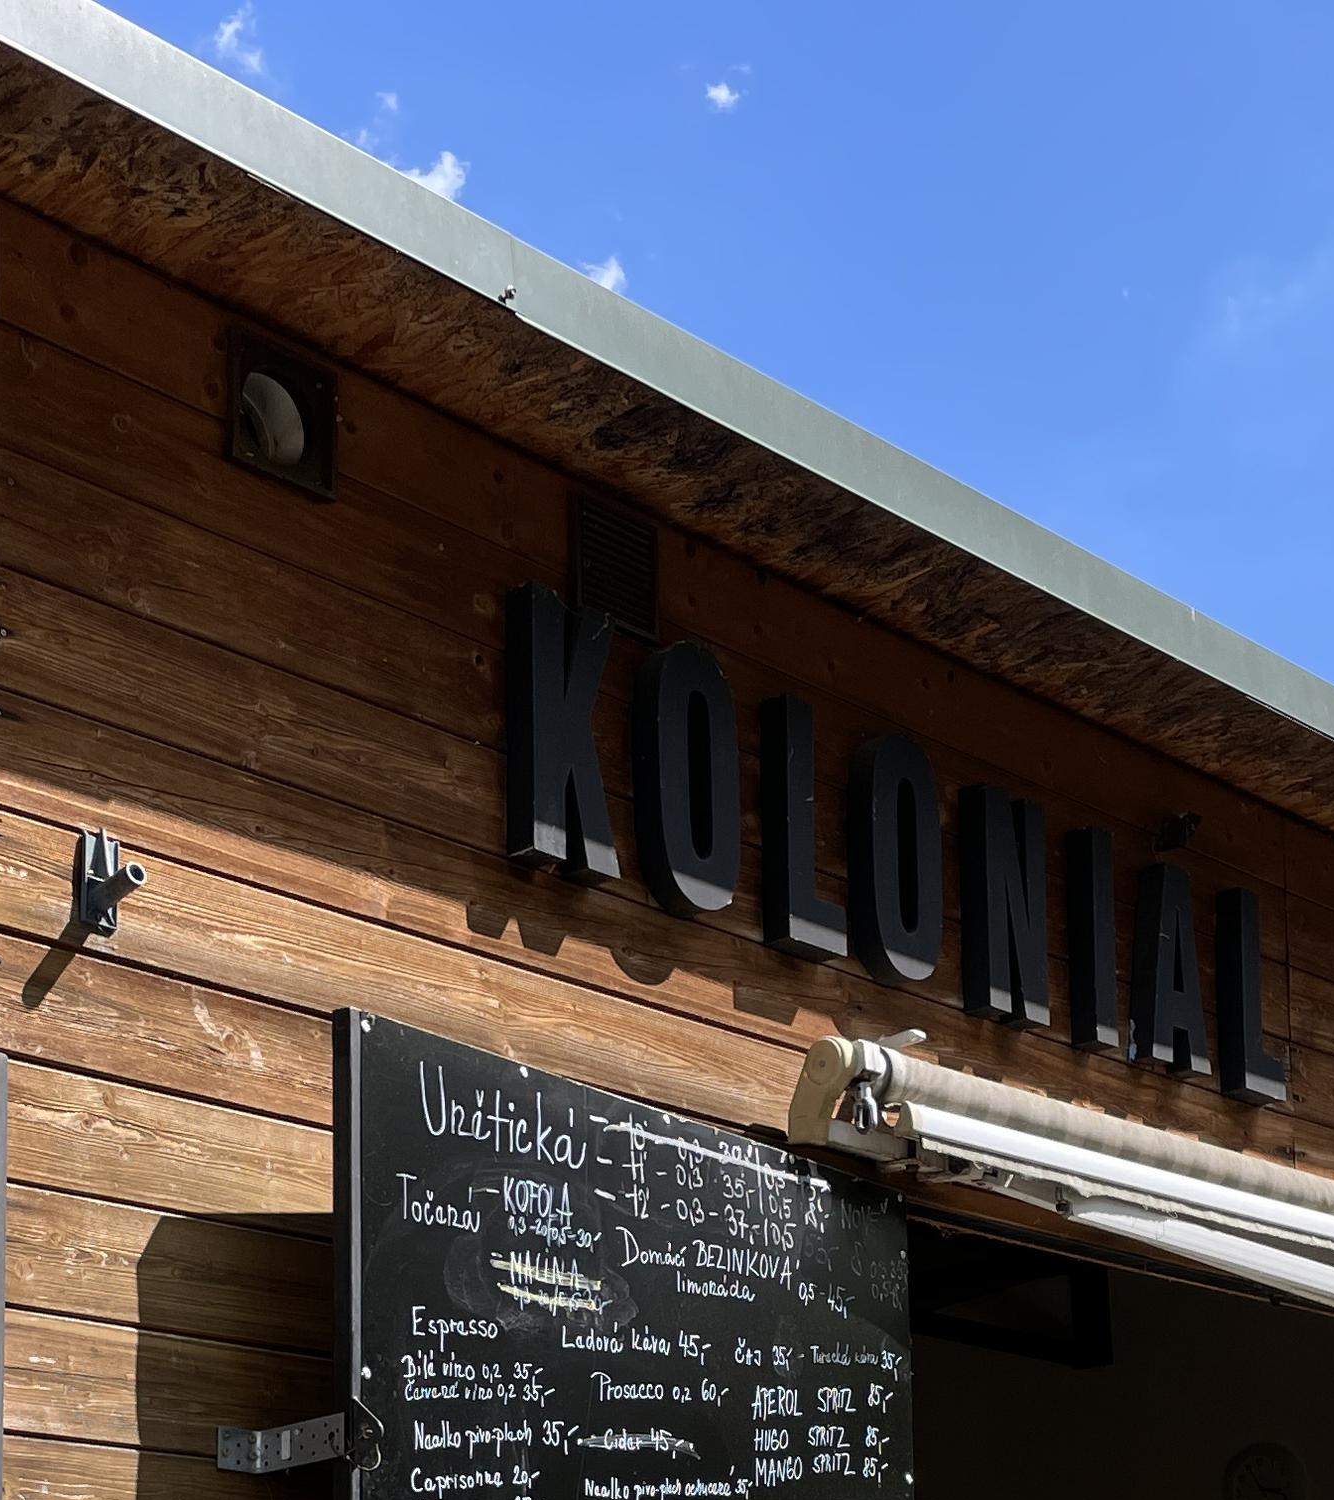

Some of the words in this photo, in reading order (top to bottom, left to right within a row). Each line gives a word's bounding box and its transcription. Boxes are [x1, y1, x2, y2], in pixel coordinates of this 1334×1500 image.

[396, 1172, 481, 1232] Točená
[503, 1176, 573, 1227] KOFOLA
[615, 1226, 687, 1268] Domácí
[692, 1239, 800, 1290] BEZINKOVÁ
[676, 1270, 756, 1302] limonáda
[412, 1305, 499, 1353] Espresso
[562, 1322, 624, 1353] Ledová
[631, 1325, 671, 1356] káva
[678, 1330, 712, 1365] 45,-
[401, 1349, 436, 1380] Bílé
[442, 1351, 476, 1381] víno
[482, 1363, 502, 1384] 0,2
[404, 1379, 460, 1402] Červené
[465, 1383, 493, 1401] víno
[497, 1384, 517, 1406] 0,2
[590, 1371, 664, 1401] Prosecco
[672, 1386, 692, 1403] 0,2
[701, 1378, 730, 1407] 60,-
[751, 1385, 803, 1421] APEROL
[817, 1386, 856, 1413] SPRITZ
[414, 1419, 461, 1451] Nealko
[542, 1420, 580, 1455] 35,-
[754, 1428, 789, 1451] HUGO
[808, 1425, 850, 1448] SPRITZ
[512, 1465, 541, 1489] 20,-
[585, 1477, 630, 1500] Nealko
[755, 1456, 803, 1487] MANGO
[812, 1451, 856, 1476] SPRITZ
